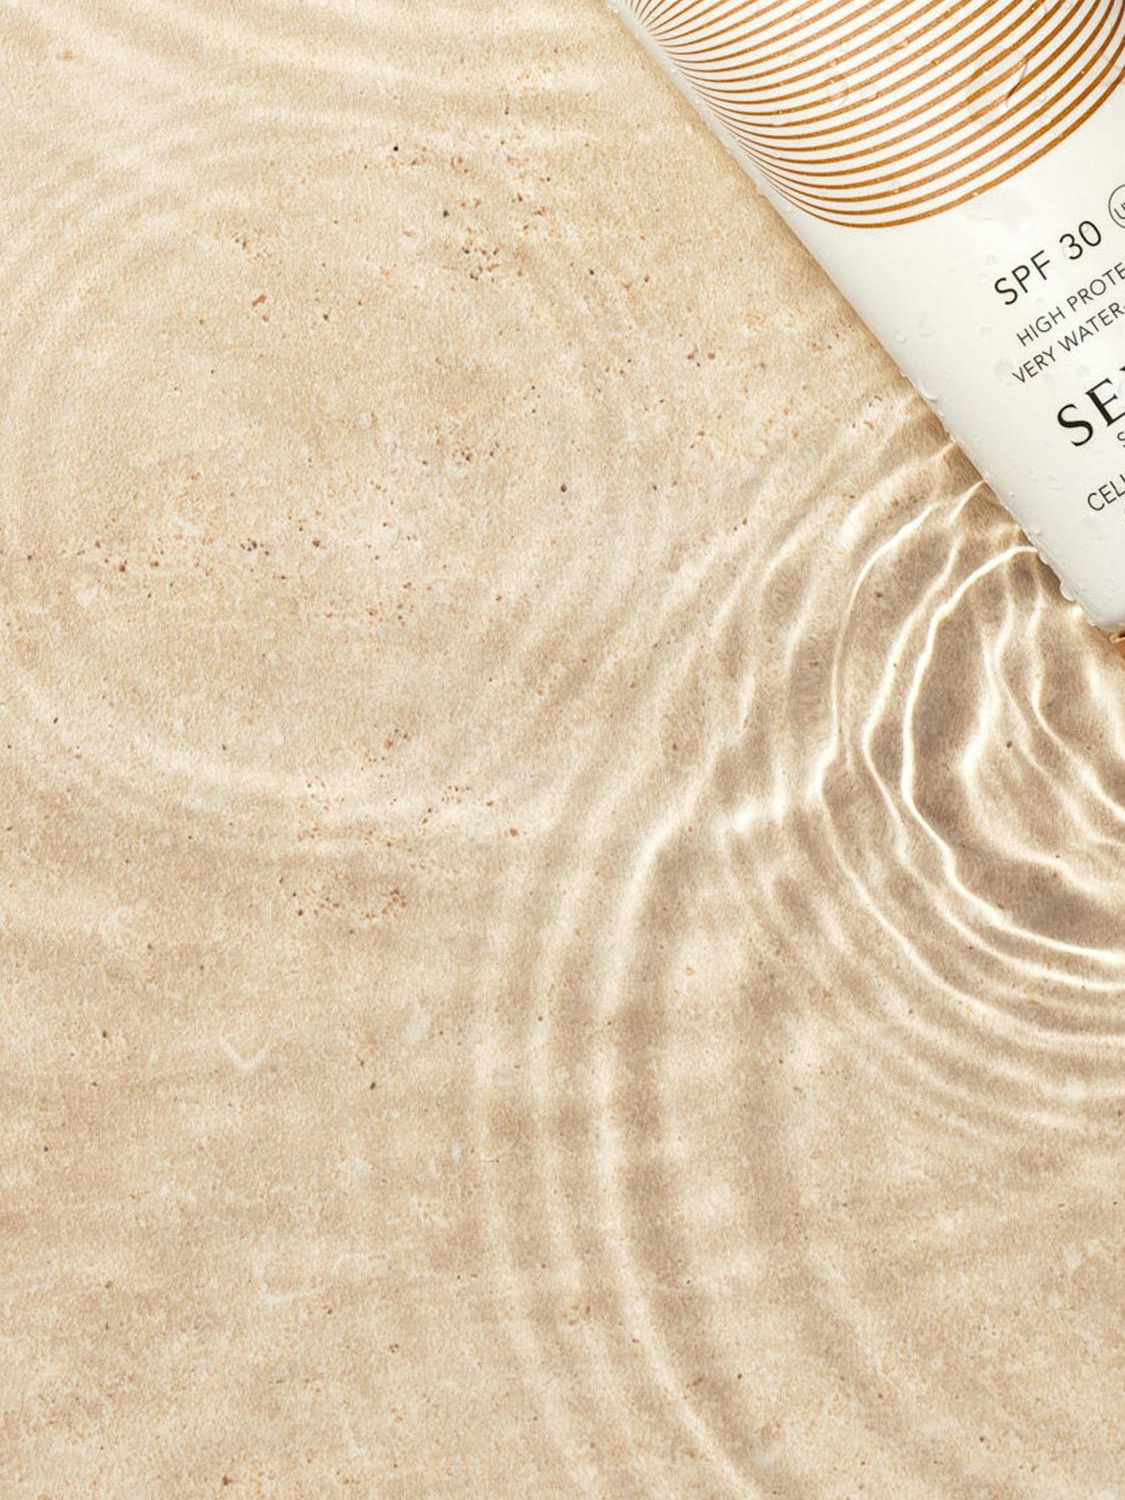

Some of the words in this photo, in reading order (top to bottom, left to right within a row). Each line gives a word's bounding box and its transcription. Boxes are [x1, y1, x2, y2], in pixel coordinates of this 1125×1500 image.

[994, 251, 1053, 305] SPF
[1059, 221, 1102, 260] 30
[1016, 306, 1066, 347] HIGH
[1011, 346, 1060, 384] VERY
